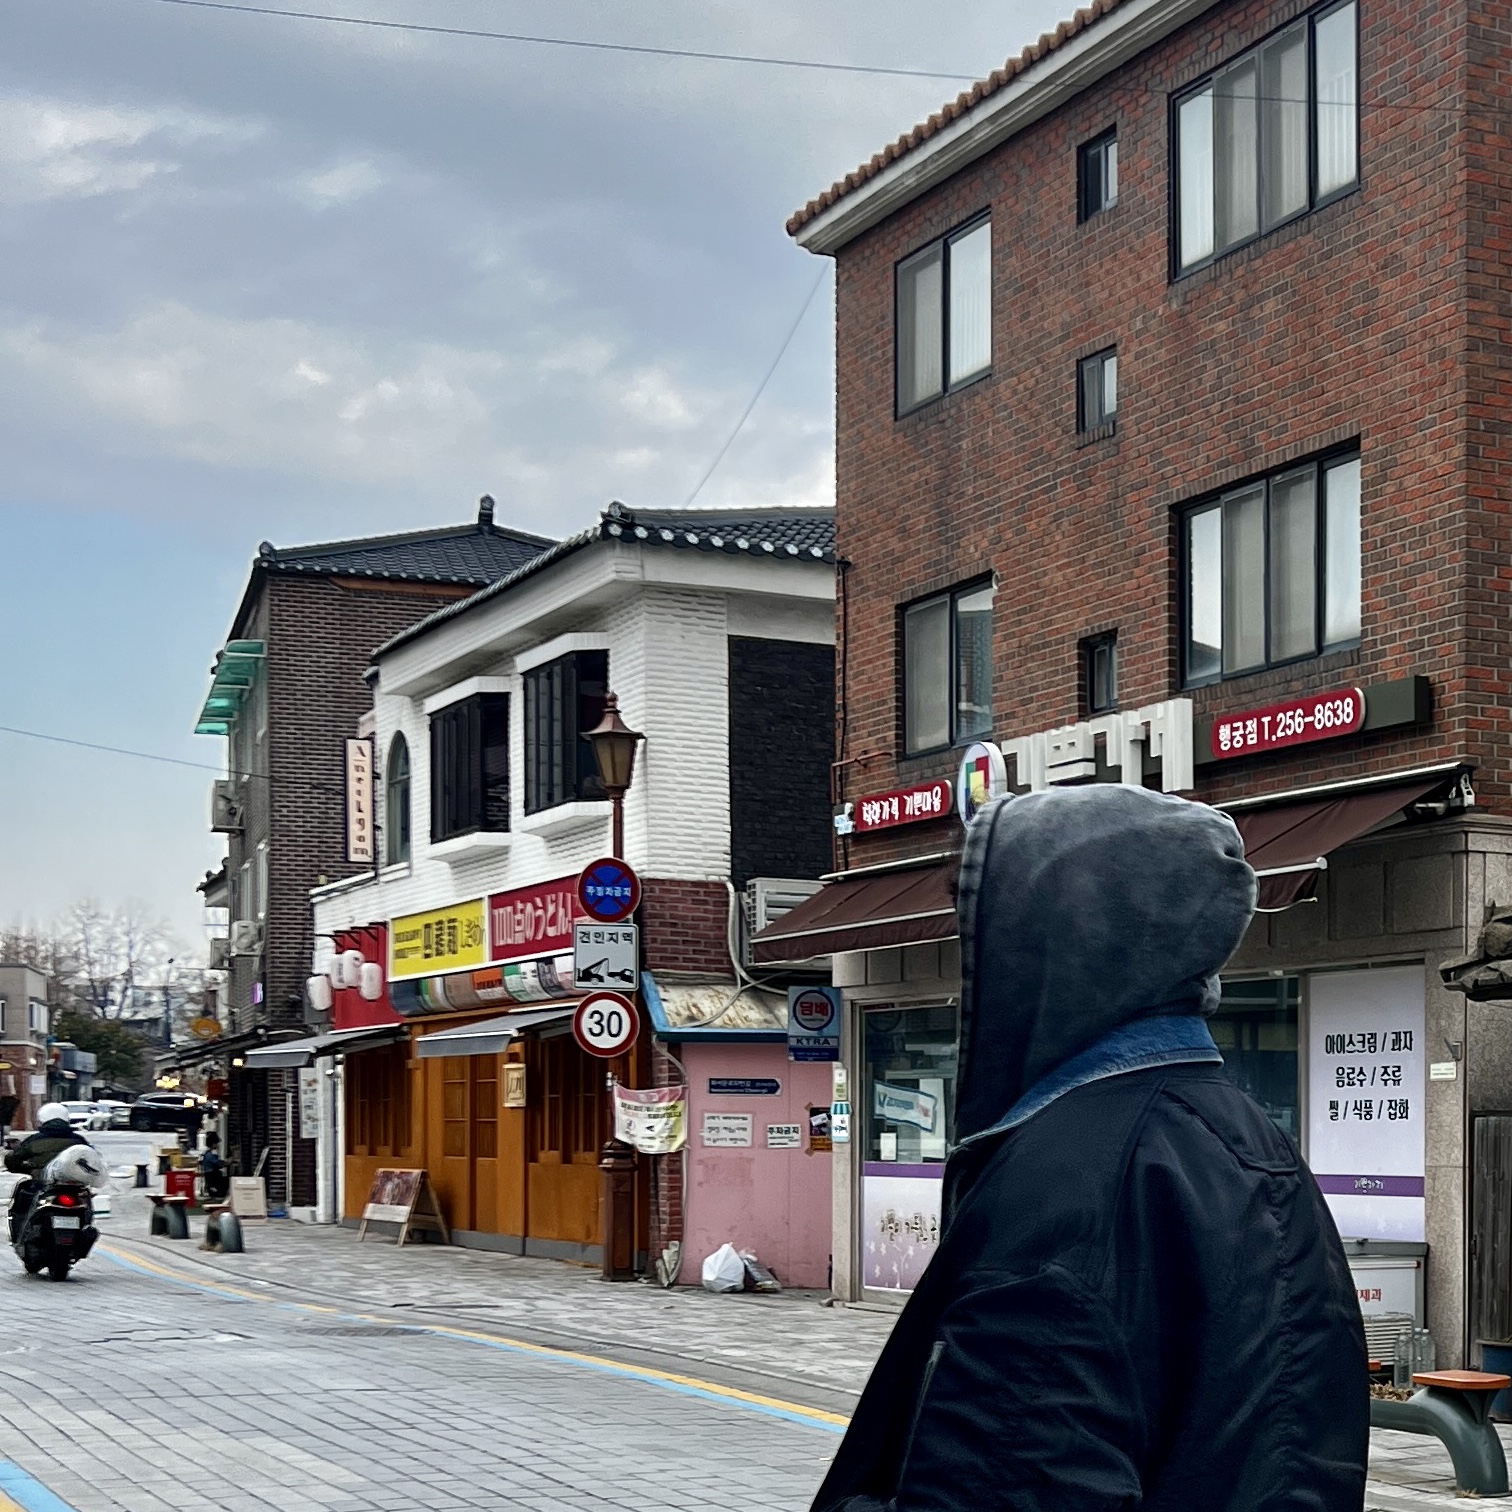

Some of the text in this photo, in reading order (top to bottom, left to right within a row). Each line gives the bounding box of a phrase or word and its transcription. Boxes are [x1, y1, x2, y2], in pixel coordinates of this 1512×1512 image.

[1218, 697, 1354, 751] 행궁점 T.256-8638
[862, 796, 900, 826] 착한가격
[903, 785, 942, 816] 기쁜마음
[578, 930, 634, 945] 견인지역
[799, 1001, 829, 1017] 담배
[588, 1010, 623, 1038] 30
[1324, 1031, 1378, 1055] 아이스크림
[1390, 1030, 1414, 1053] 과자
[1335, 1065, 1367, 1088] 음료수
[1380, 1064, 1403, 1087] 주류
[1352, 1099, 1374, 1121] 식품
[1387, 1098, 1410, 1121] 잡화
[767, 1126, 800, 1135] 주차금지
[1356, 1288, 1382, 1303] 제과
